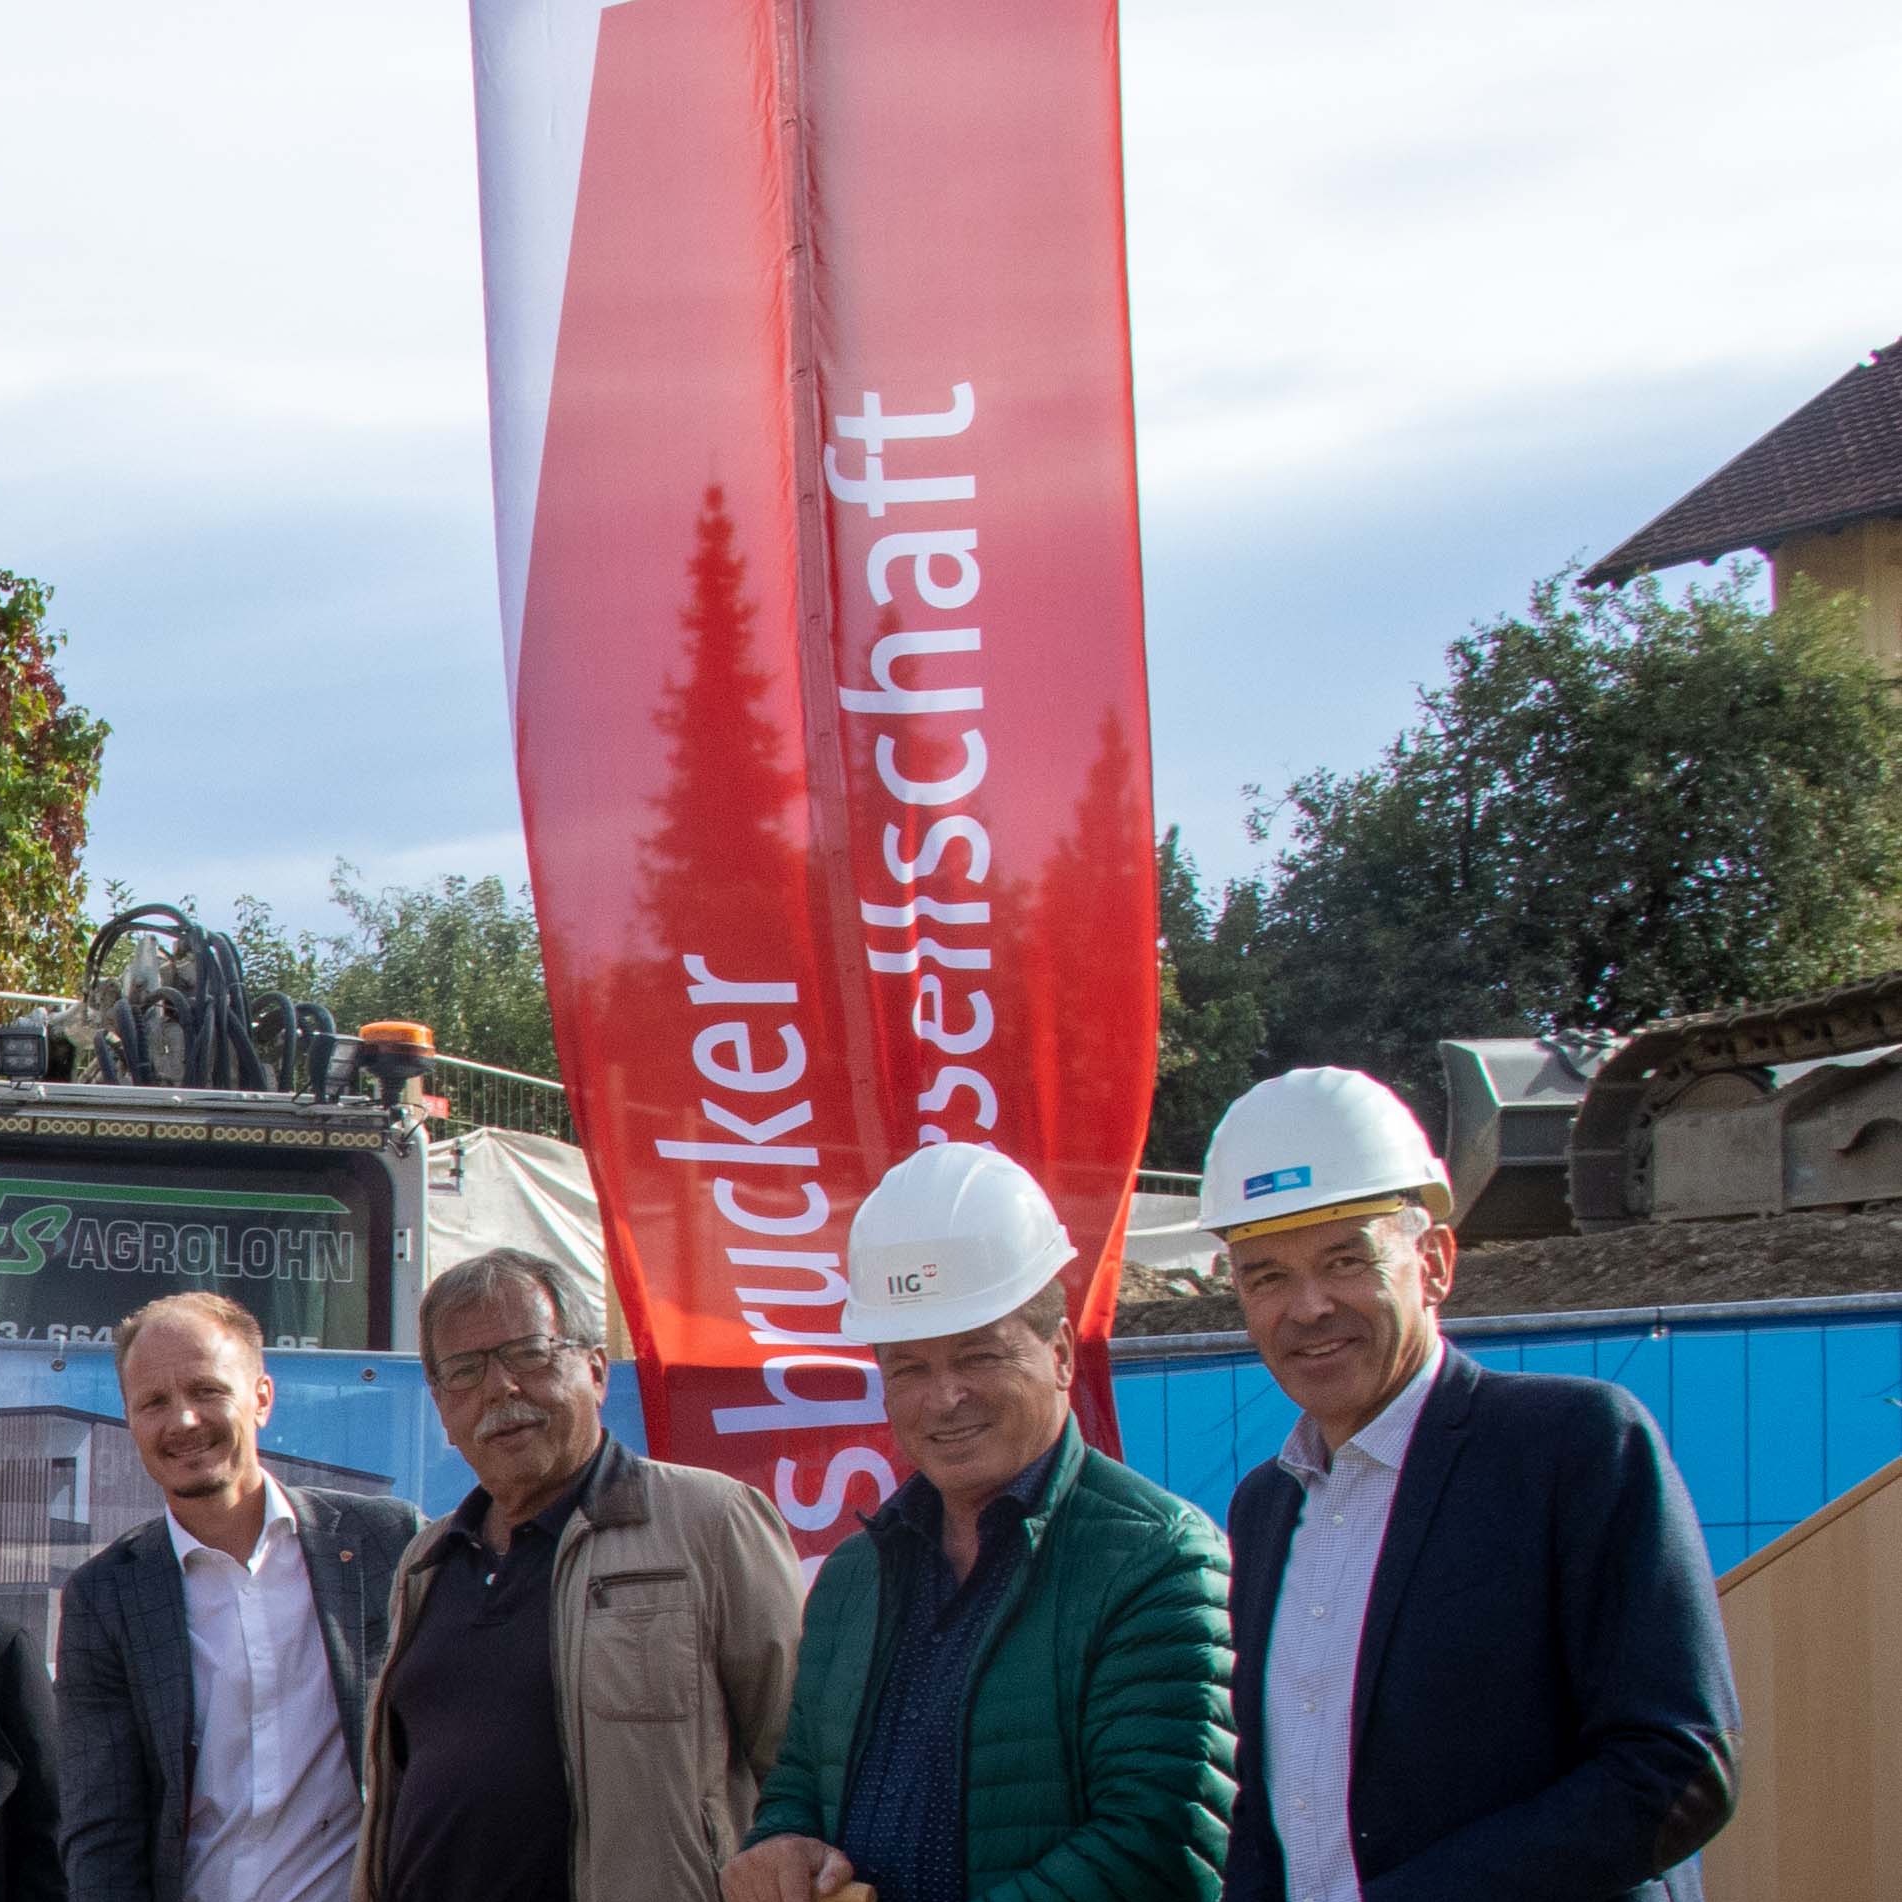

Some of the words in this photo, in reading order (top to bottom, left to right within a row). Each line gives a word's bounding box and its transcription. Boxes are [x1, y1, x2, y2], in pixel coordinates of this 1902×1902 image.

[823, 381, 998, 1145] sellschaft
[68, 1218, 354, 1282] AGROLOHN
[655, 954, 899, 1565] sbrucker
[887, 1273, 922, 1295] IIG
